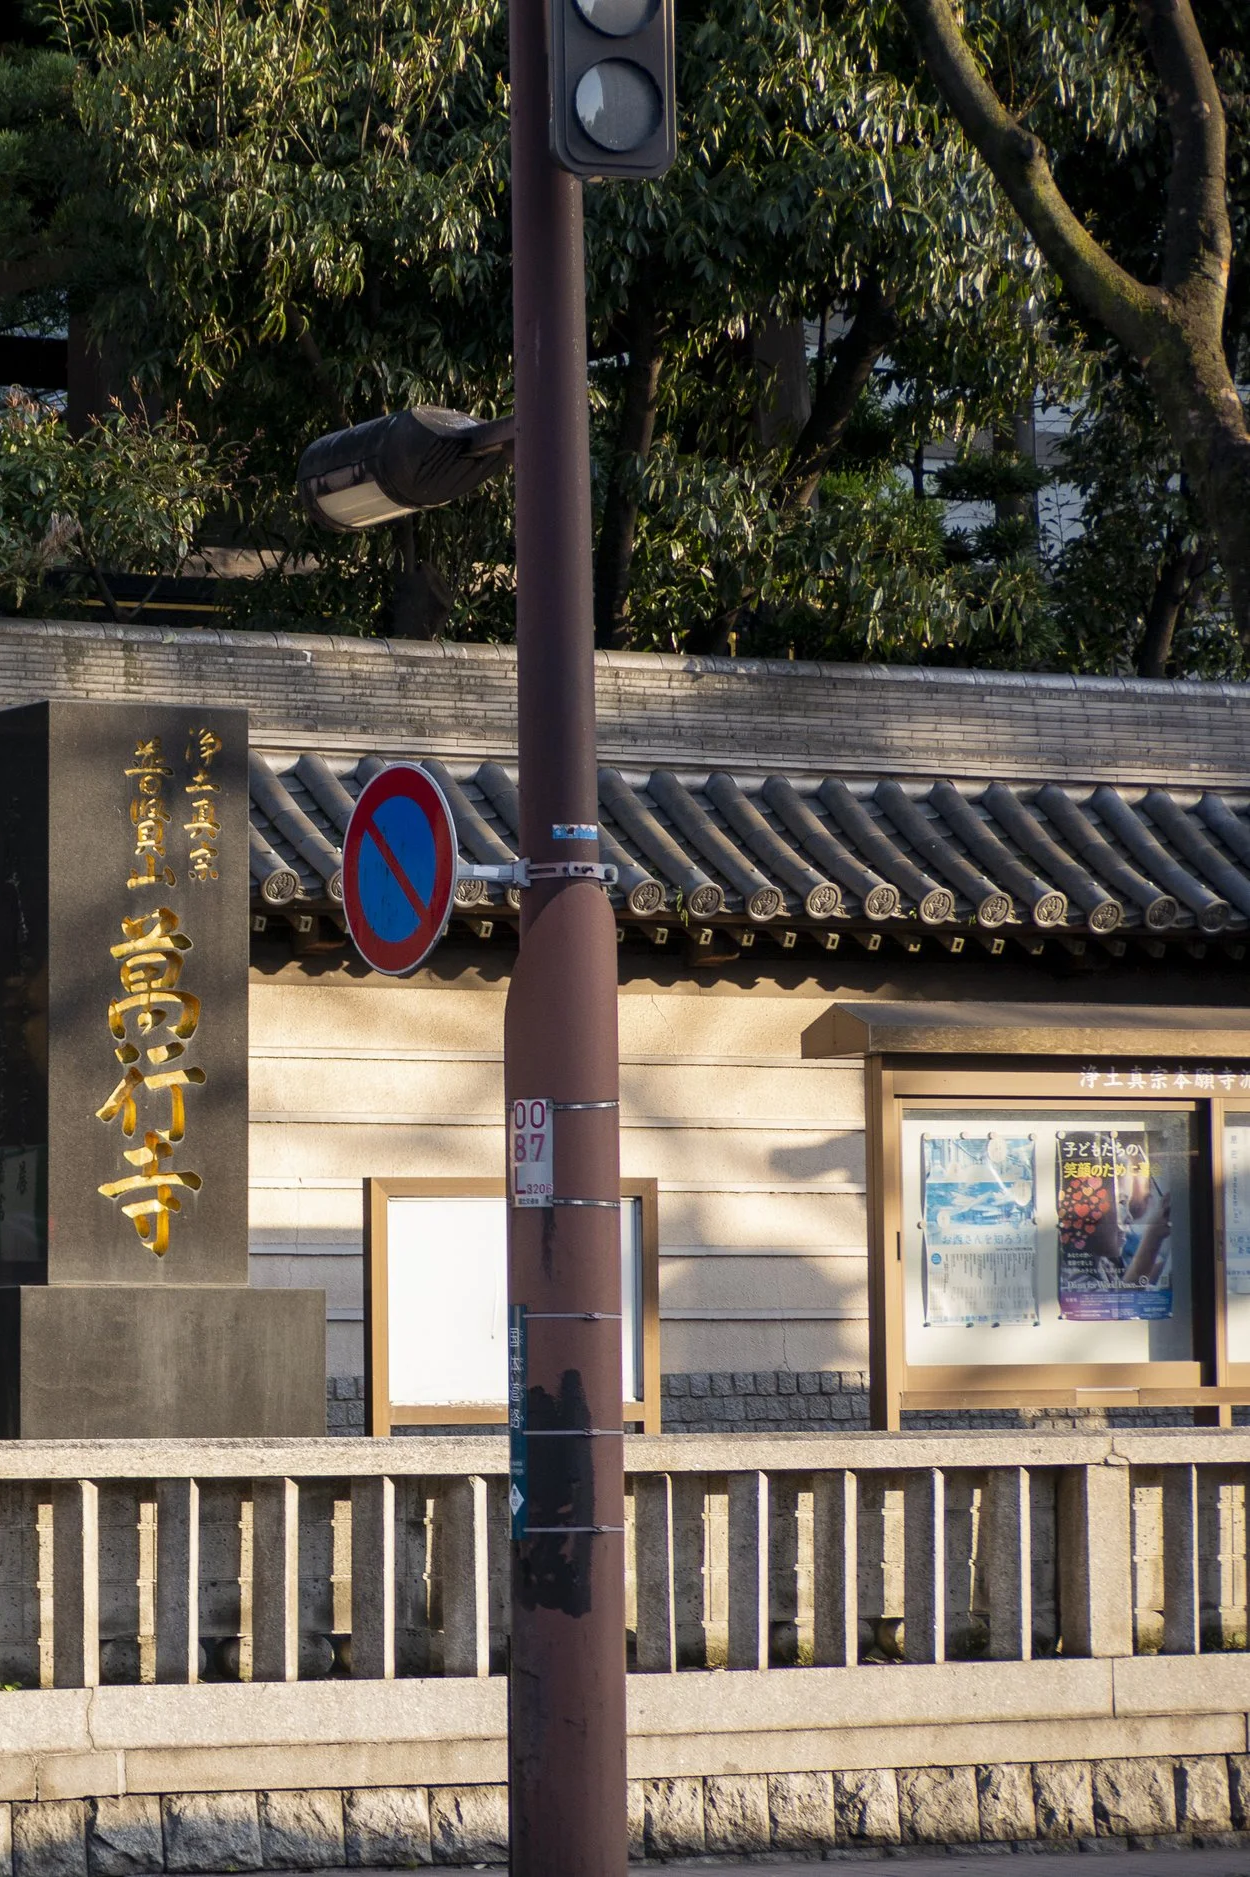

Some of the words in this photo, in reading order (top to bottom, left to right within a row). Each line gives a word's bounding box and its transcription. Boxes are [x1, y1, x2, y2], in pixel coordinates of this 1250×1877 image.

[95, 907, 208, 1259] 萬行寺
[514, 1101, 545, 1129] 00
[514, 1133, 545, 1162] 87
